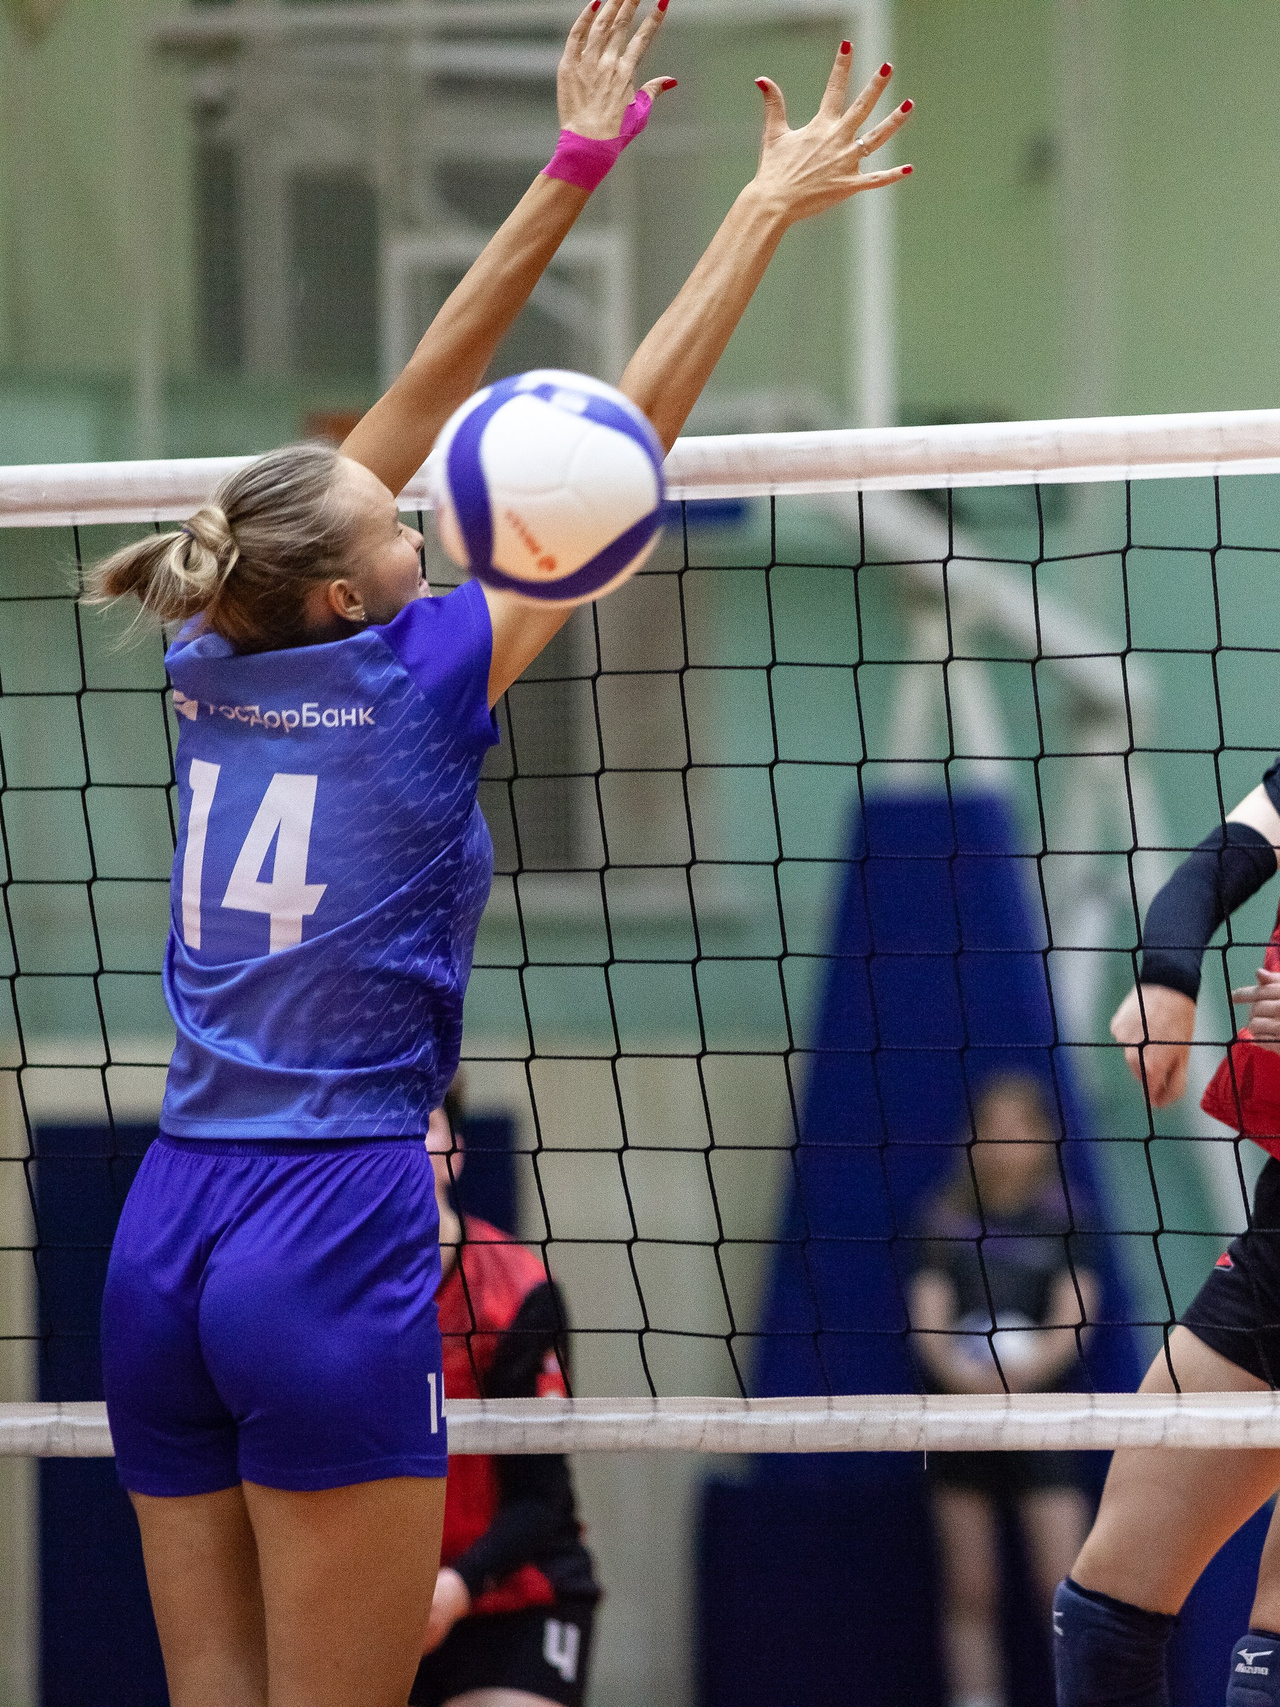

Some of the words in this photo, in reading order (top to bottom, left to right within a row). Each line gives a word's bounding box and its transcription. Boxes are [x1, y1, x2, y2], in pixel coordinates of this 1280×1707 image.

[181, 758, 328, 955] 14
[427, 1372, 447, 1434] 1
[543, 1617, 580, 1682] 4
